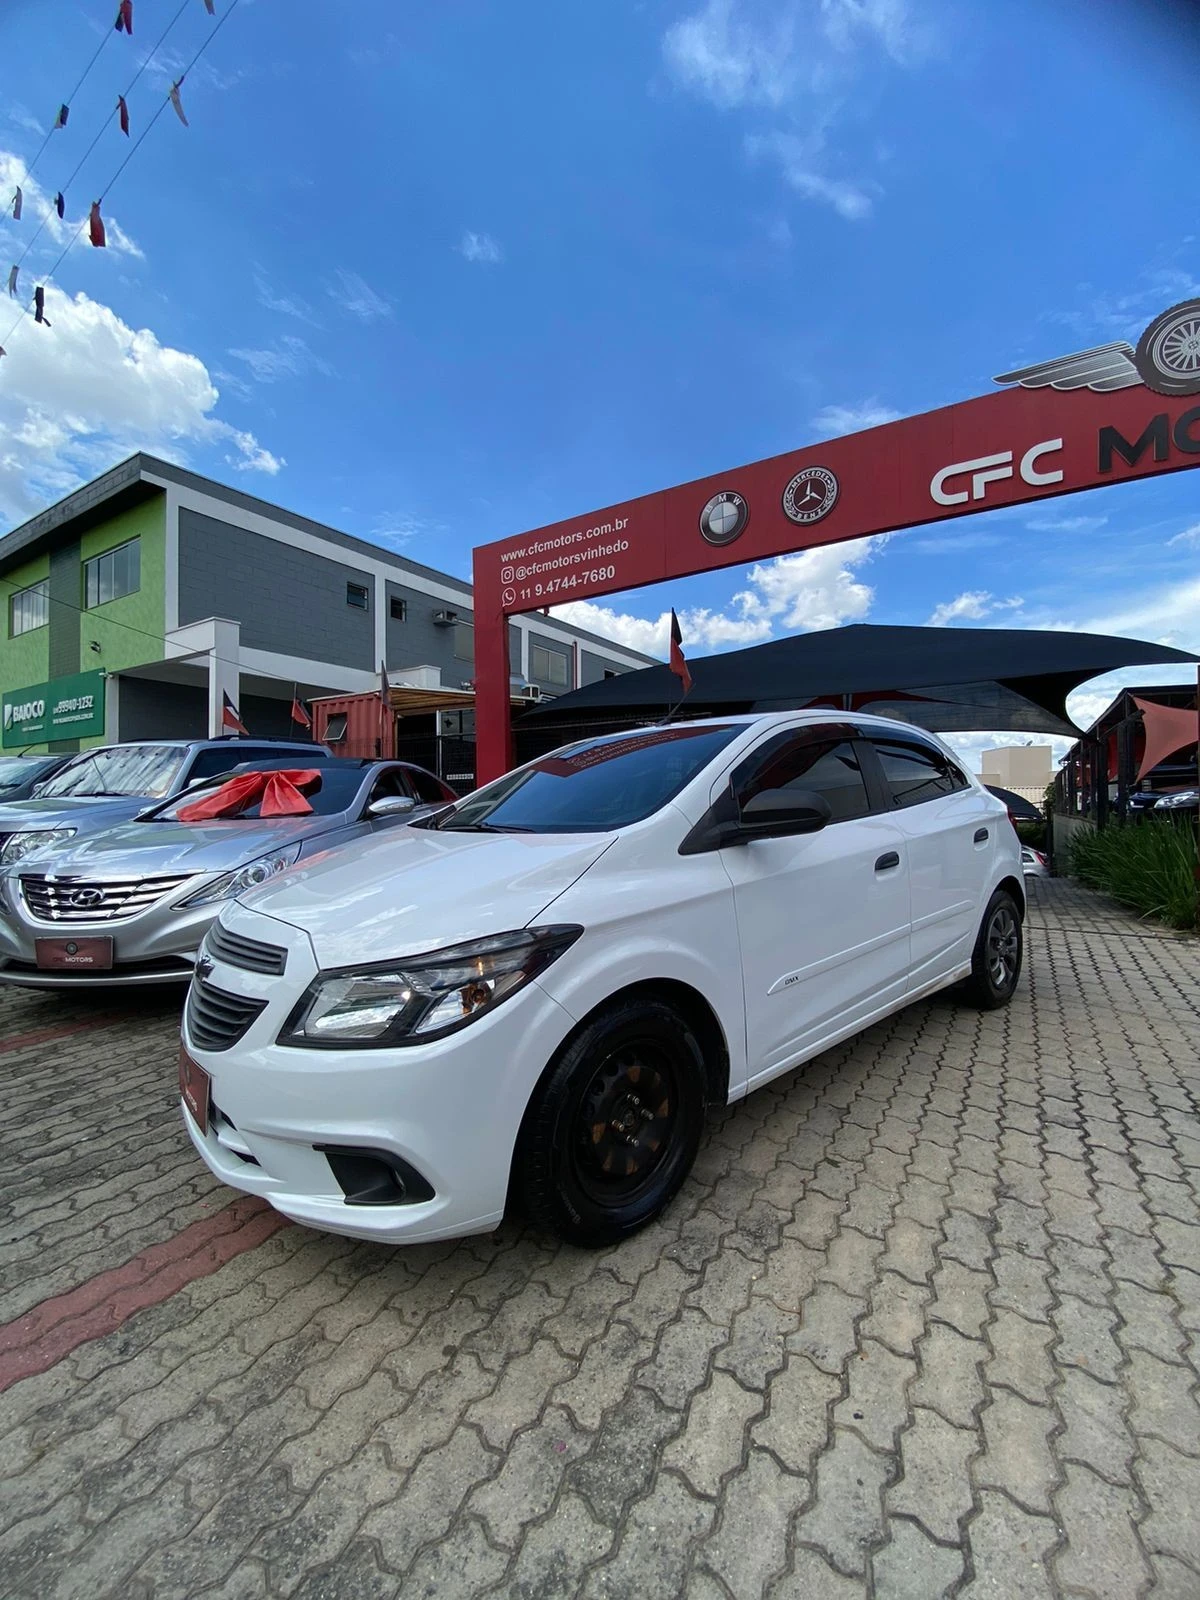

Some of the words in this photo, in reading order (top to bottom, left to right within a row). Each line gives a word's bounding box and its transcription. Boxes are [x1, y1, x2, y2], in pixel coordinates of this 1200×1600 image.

[791, 470, 830, 489] MERCEDES
[930, 437, 1064, 506] CFC
[706, 493, 742, 514] BMW
[501, 518, 629, 562] www.cfcmotors.com.br
[515, 540, 629, 581] @cfcmotorsvinhedo
[520, 588, 531, 600] 11
[535, 565, 615, 596] 9.4744-7680
